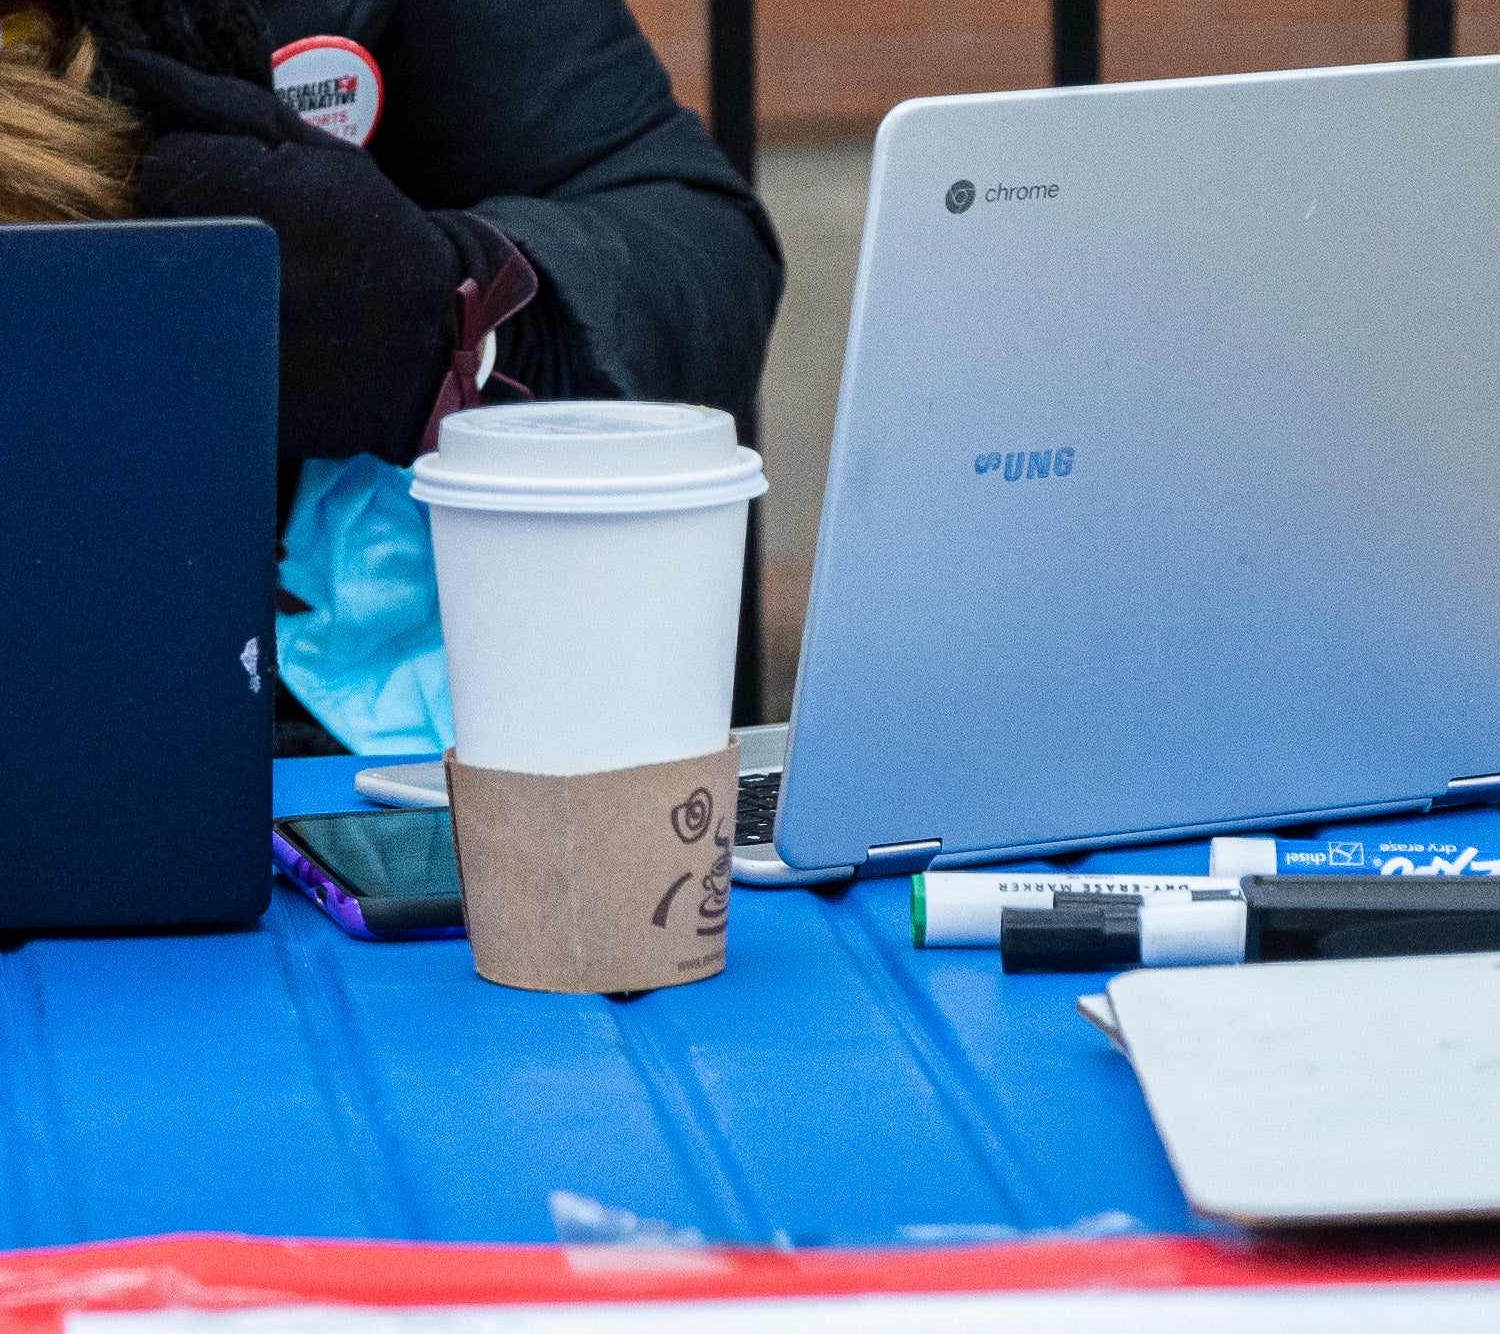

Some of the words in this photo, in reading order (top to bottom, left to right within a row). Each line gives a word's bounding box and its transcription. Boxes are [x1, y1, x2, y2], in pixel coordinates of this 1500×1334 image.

[985, 183, 1060, 202] chrome
[1379, 842, 1426, 853] erase
[1428, 842, 1457, 855] dry
[1285, 851, 1327, 866] chisel
[999, 882, 1072, 893] MARKER
